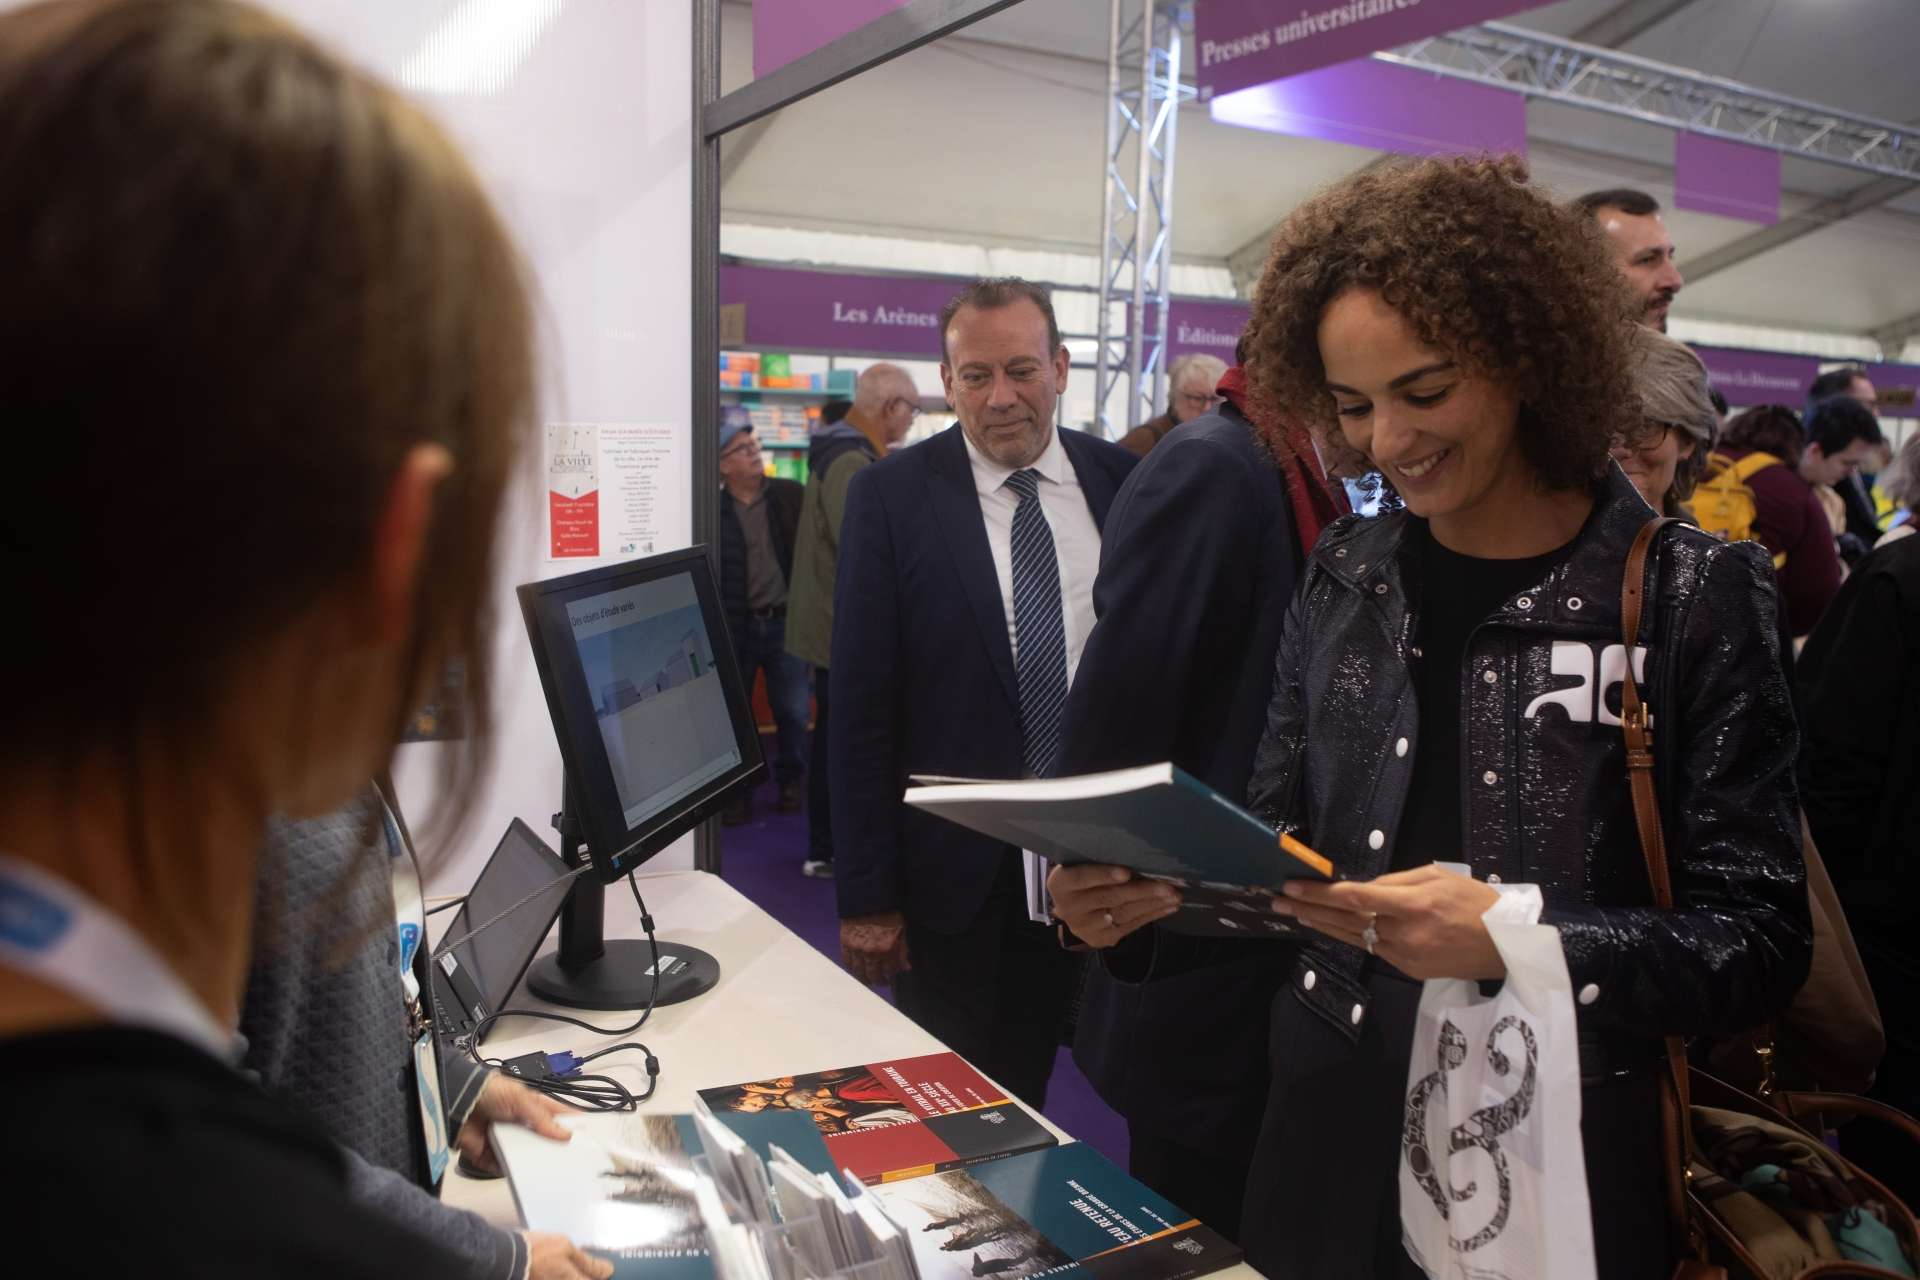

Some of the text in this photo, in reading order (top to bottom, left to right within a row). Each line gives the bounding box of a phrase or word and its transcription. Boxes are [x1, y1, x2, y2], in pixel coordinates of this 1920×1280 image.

[1201, 32, 1271, 67] Presses
[833, 301, 938, 328] Les Arènes
[1085, 1194, 1109, 1210] GRANDE
[1068, 1198, 1114, 1228] RETENUE
[1105, 1207, 1116, 1216] LA
[1112, 1213, 1124, 1221] DE
[1119, 1218, 1143, 1234] ÉTANGS
